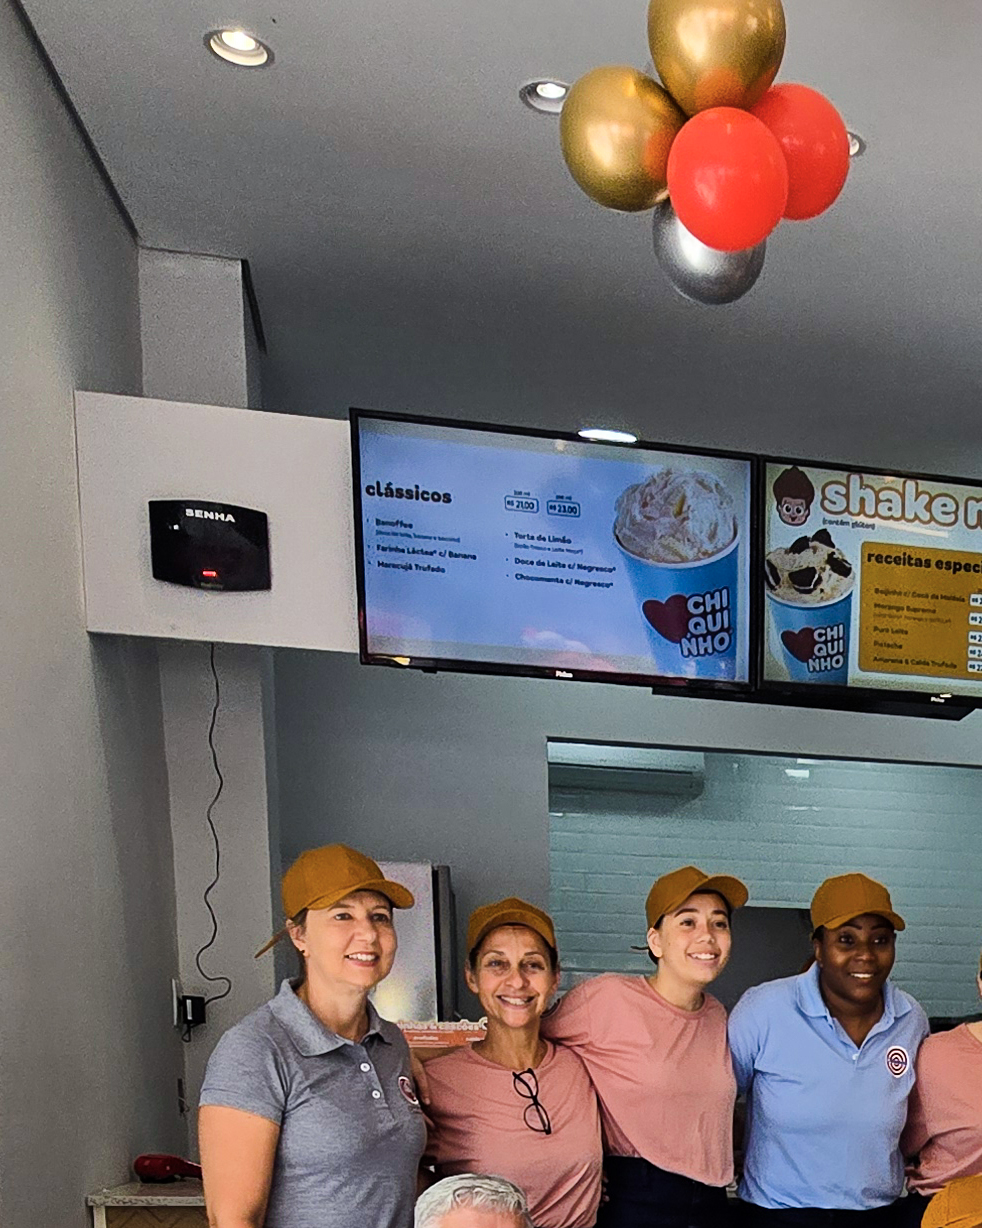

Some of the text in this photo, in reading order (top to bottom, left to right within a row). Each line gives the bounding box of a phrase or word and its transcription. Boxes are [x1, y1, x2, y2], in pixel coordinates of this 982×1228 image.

[365, 480, 452, 504] clássicos
[820, 472, 959, 527] shake
[185, 508, 236, 523] SENHA
[514, 531, 535, 541] Torta
[547, 535, 572, 544] Limão
[448, 550, 477, 561] Banana
[514, 557, 535, 566] Doce
[547, 560, 566, 569] Leite
[867, 552, 931, 569] receitas
[377, 560, 446, 574] Maracujá Trufado
[687, 588, 729, 615] CHI
[687, 610, 729, 636] QUI
[813, 624, 844, 643] CHI
[681, 631, 731, 657] NHO
[813, 639, 844, 657] QUI
[808, 655, 844, 672] NHO
